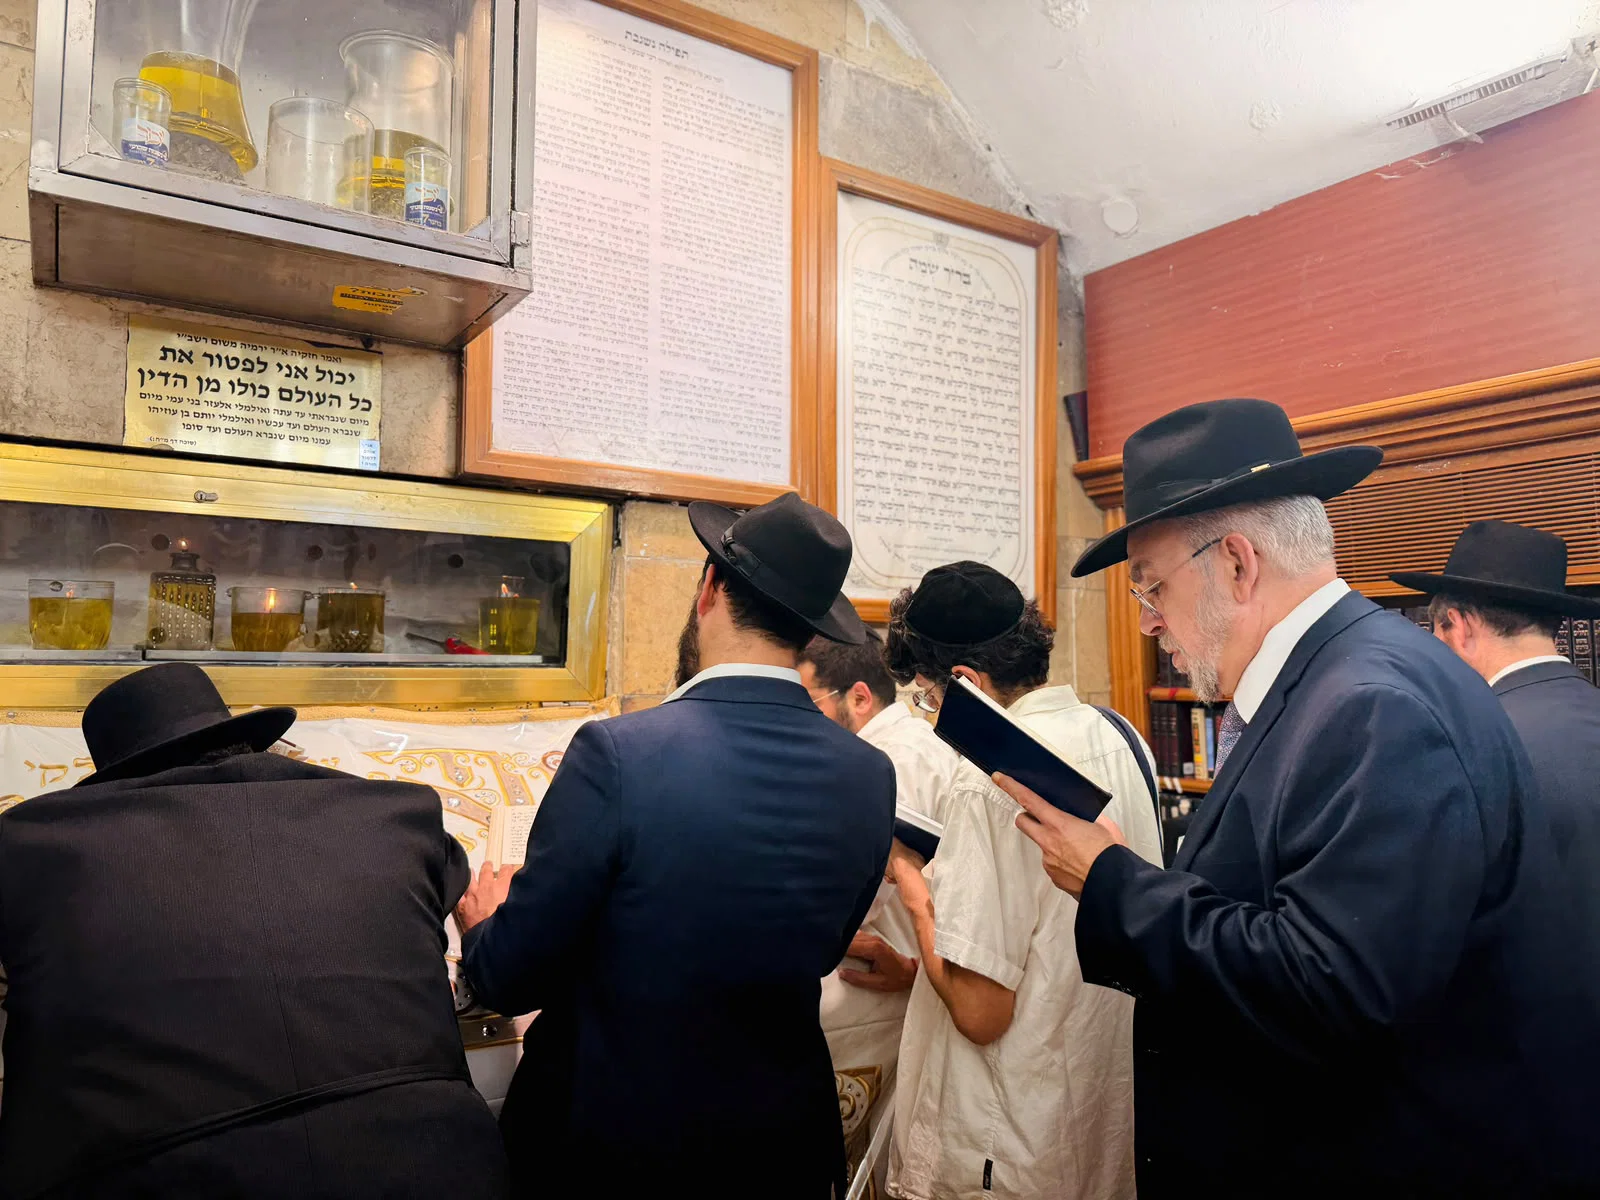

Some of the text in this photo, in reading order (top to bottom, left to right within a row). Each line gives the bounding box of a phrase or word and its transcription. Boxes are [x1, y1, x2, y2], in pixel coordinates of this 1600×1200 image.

[210, 339, 237, 348] משום
[240, 342, 268, 352] ירמיה
[290, 350, 318, 360] חזקיה
[158, 345, 356, 385] יכול אני לפטור את
[320, 354, 342, 363] ואמר
[136, 367, 373, 412] כל העולם כולו מן הדין
[139, 391, 370, 426] מיום שנבראתי עד עתה ואילמלי אלעזר בני עמי מיום
[147, 405, 361, 437] שנברא העולם ועד עכשיו ואילמלי יותם בן עוזיהו
[181, 422, 331, 446] עמנו מיום שנברא העולם ועד סופו
